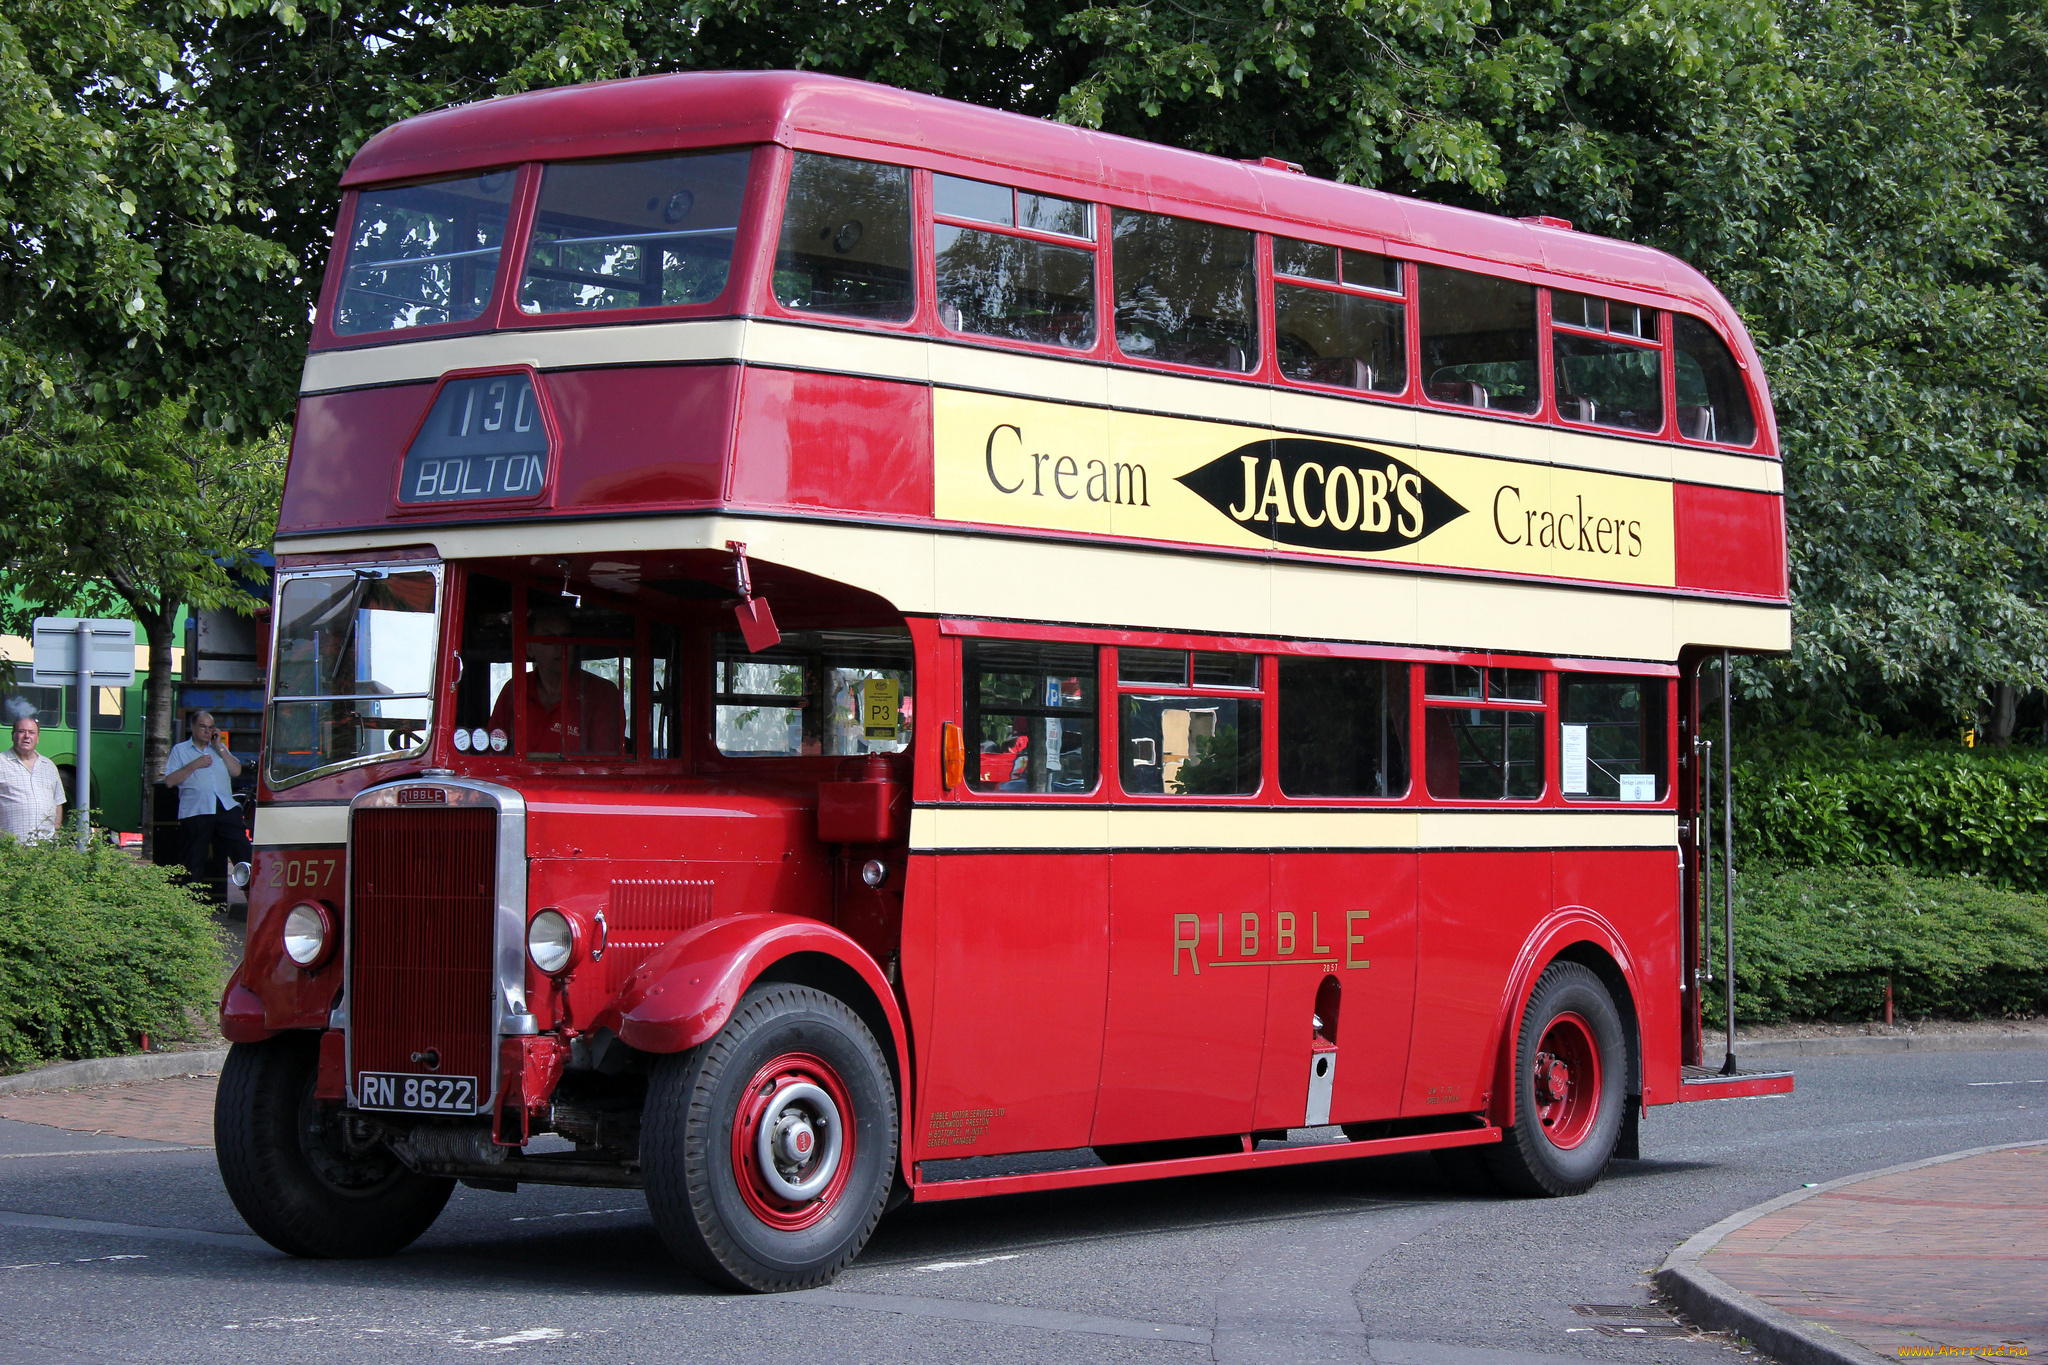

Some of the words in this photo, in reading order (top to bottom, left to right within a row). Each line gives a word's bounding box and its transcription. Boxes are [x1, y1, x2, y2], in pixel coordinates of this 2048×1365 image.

[415, 454, 545, 497] BOLTON
[985, 423, 1151, 507] Cream
[1229, 455, 1424, 539] JACOB'S
[1493, 485, 1642, 557] Crackers
[872, 705, 890, 721] P3
[400, 789, 443, 803] RIBBLE
[269, 859, 336, 887] 2057
[1173, 910, 1370, 976] RIBBLE
[1323, 963, 1338, 973] 2057
[363, 1076, 395, 1106] RN
[403, 1078, 471, 1110] 8622
[930, 1111, 949, 1120] RIBBLE
[951, 1110, 969, 1119] MOTOR
[969, 1108, 994, 1118] SERVICES
[965, 1118, 990, 1127] PRESTON
[927, 1138, 950, 1148] GENERAL
